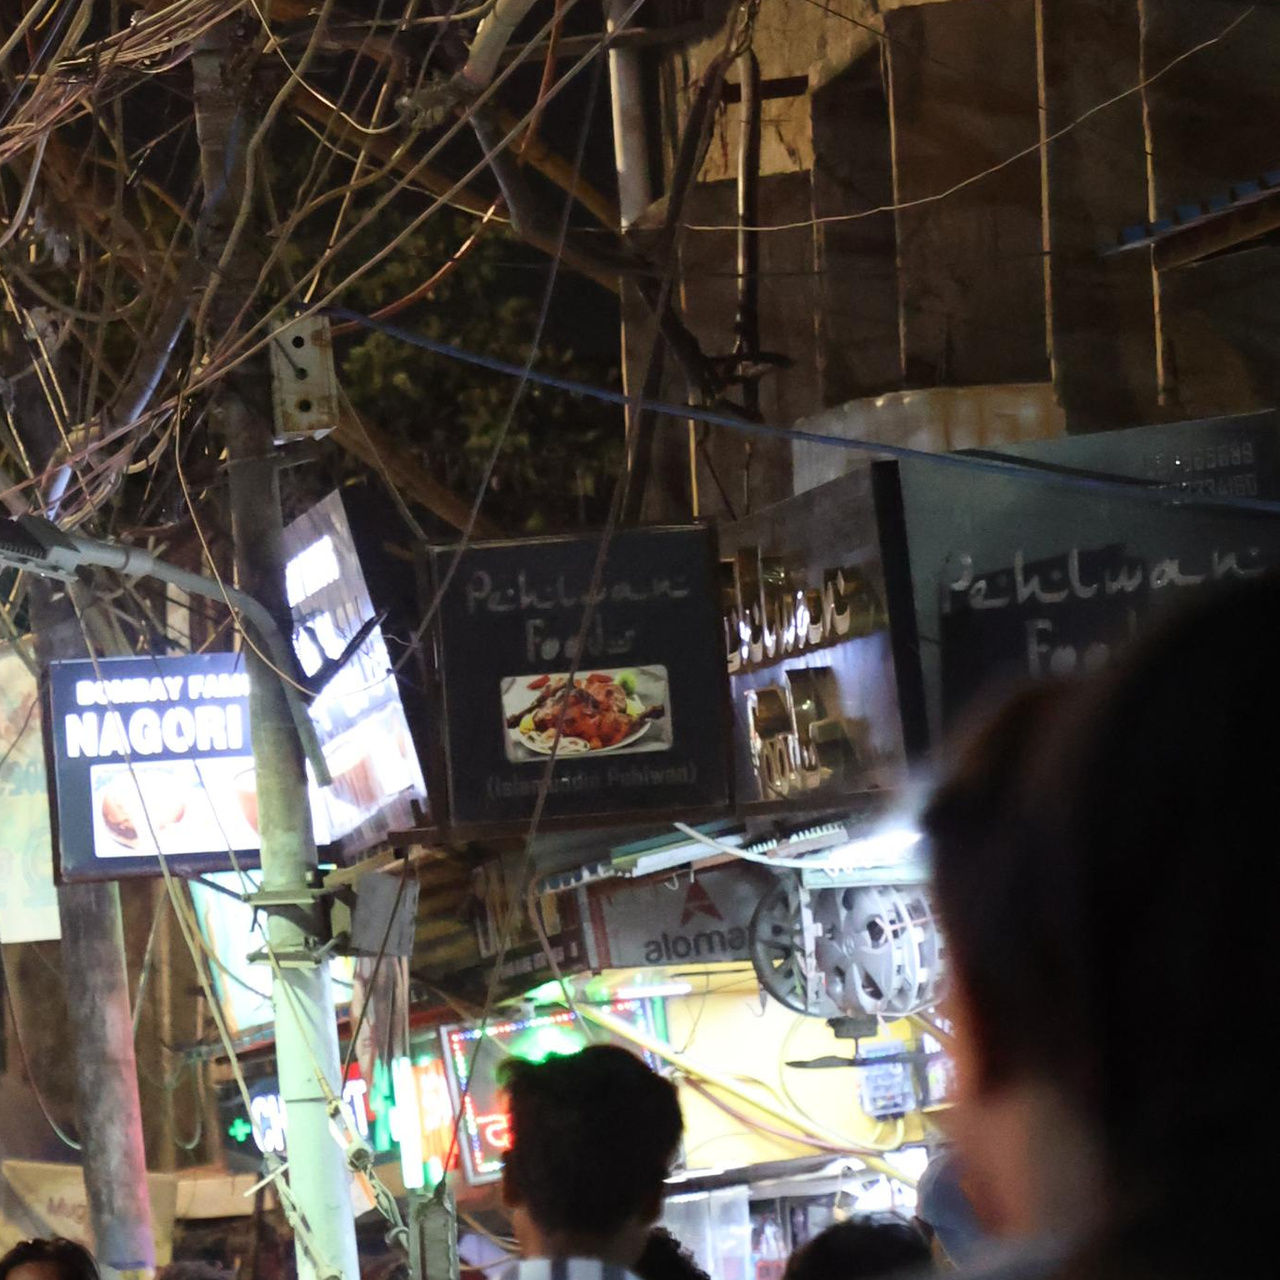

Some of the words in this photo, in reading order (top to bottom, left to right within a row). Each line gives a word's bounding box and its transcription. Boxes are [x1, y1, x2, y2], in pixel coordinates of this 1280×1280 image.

[942, 547, 1267, 613] Pehlwan
[76, 676, 184, 707] BOMBAY
[65, 704, 243, 758] NAGORI
